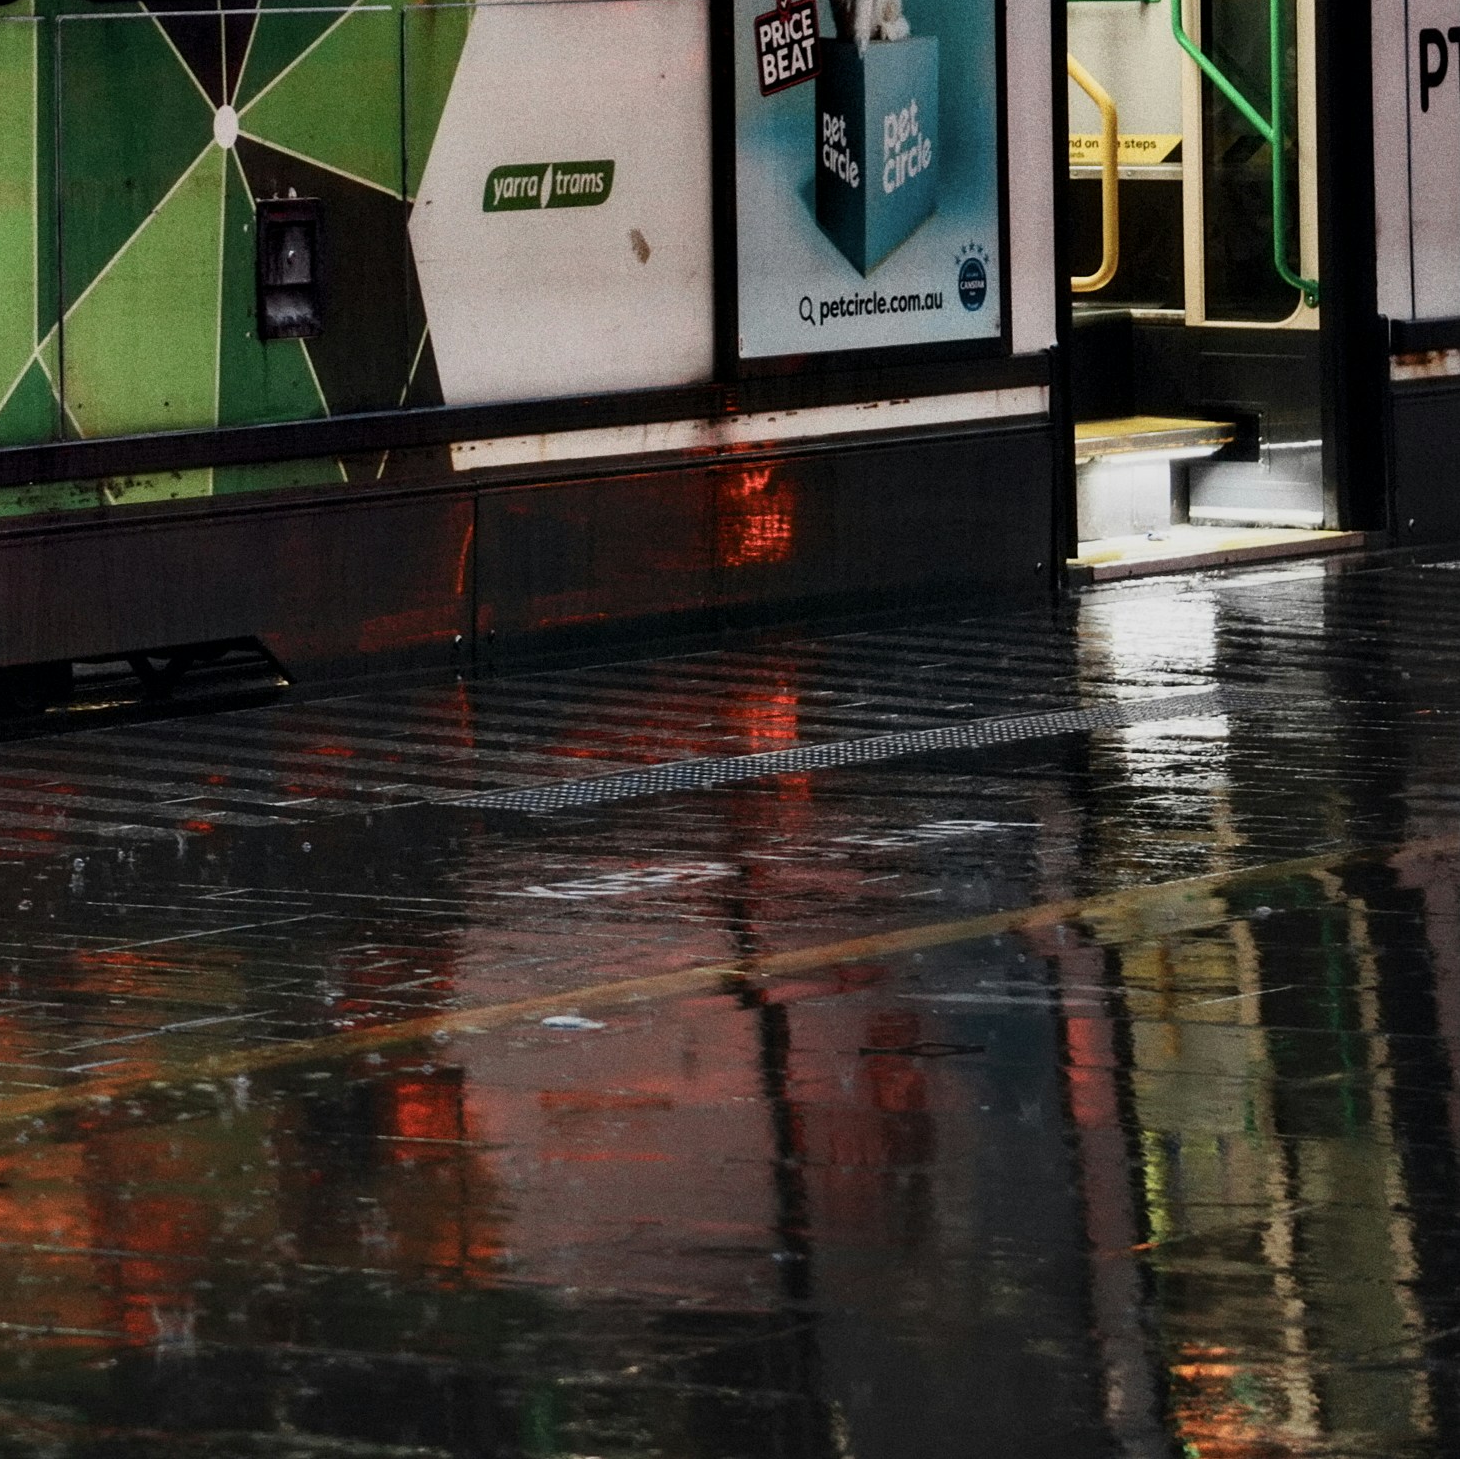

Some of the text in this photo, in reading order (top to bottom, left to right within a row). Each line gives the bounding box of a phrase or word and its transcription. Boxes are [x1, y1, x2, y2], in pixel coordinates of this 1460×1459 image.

[759, 7, 814, 54] PRICE
[762, 39, 816, 86] BEAT
[823, 111, 847, 147] pet
[883, 97, 919, 159] pet
[1124, 139, 1157, 151] steps
[822, 142, 860, 189] circle
[882, 131, 932, 195] circle
[493, 169, 605, 206] yarra trams
[819, 290, 943, 325] petcircle.com.au
